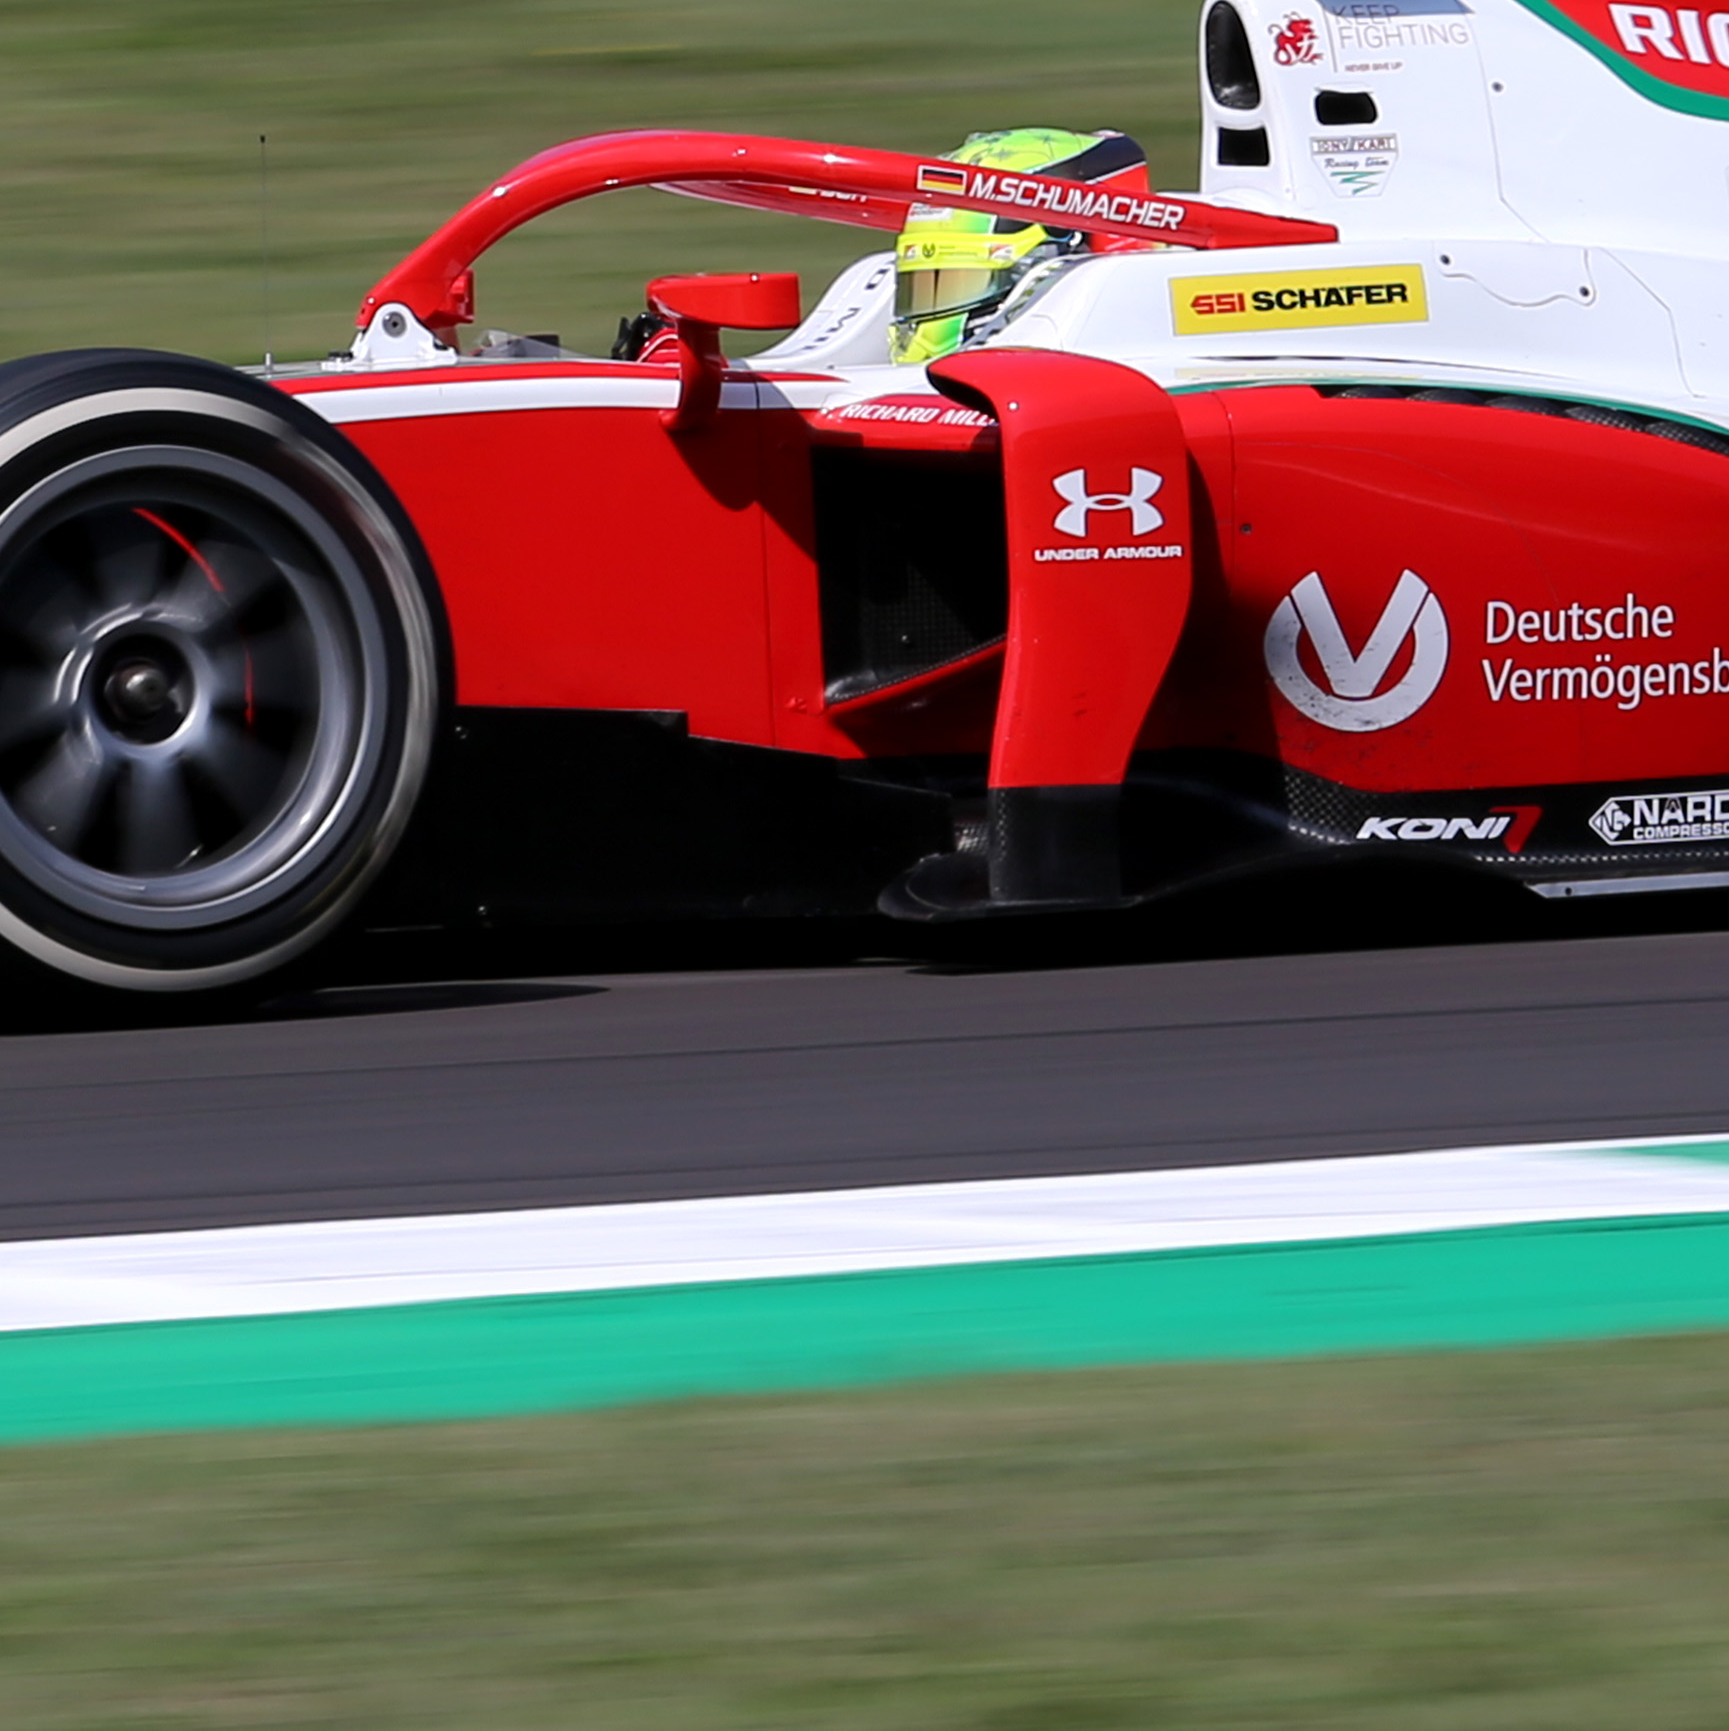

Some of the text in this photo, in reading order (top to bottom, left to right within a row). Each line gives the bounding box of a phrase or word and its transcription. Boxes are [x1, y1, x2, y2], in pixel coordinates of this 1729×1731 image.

[1333, 4, 1400, 25] KEEP
[1338, 23, 1470, 49] FIGHTING
[969, 172, 1184, 230] M.SCHUMACHER
[1190, 282, 1408, 315] SSI SCHÄFER
[841, 404, 940, 423] RICHARD
[1034, 545, 1182, 562] UNDER ARMOUR
[1486, 593, 1674, 644] Deutsche
[1356, 817, 1511, 840] KONI
